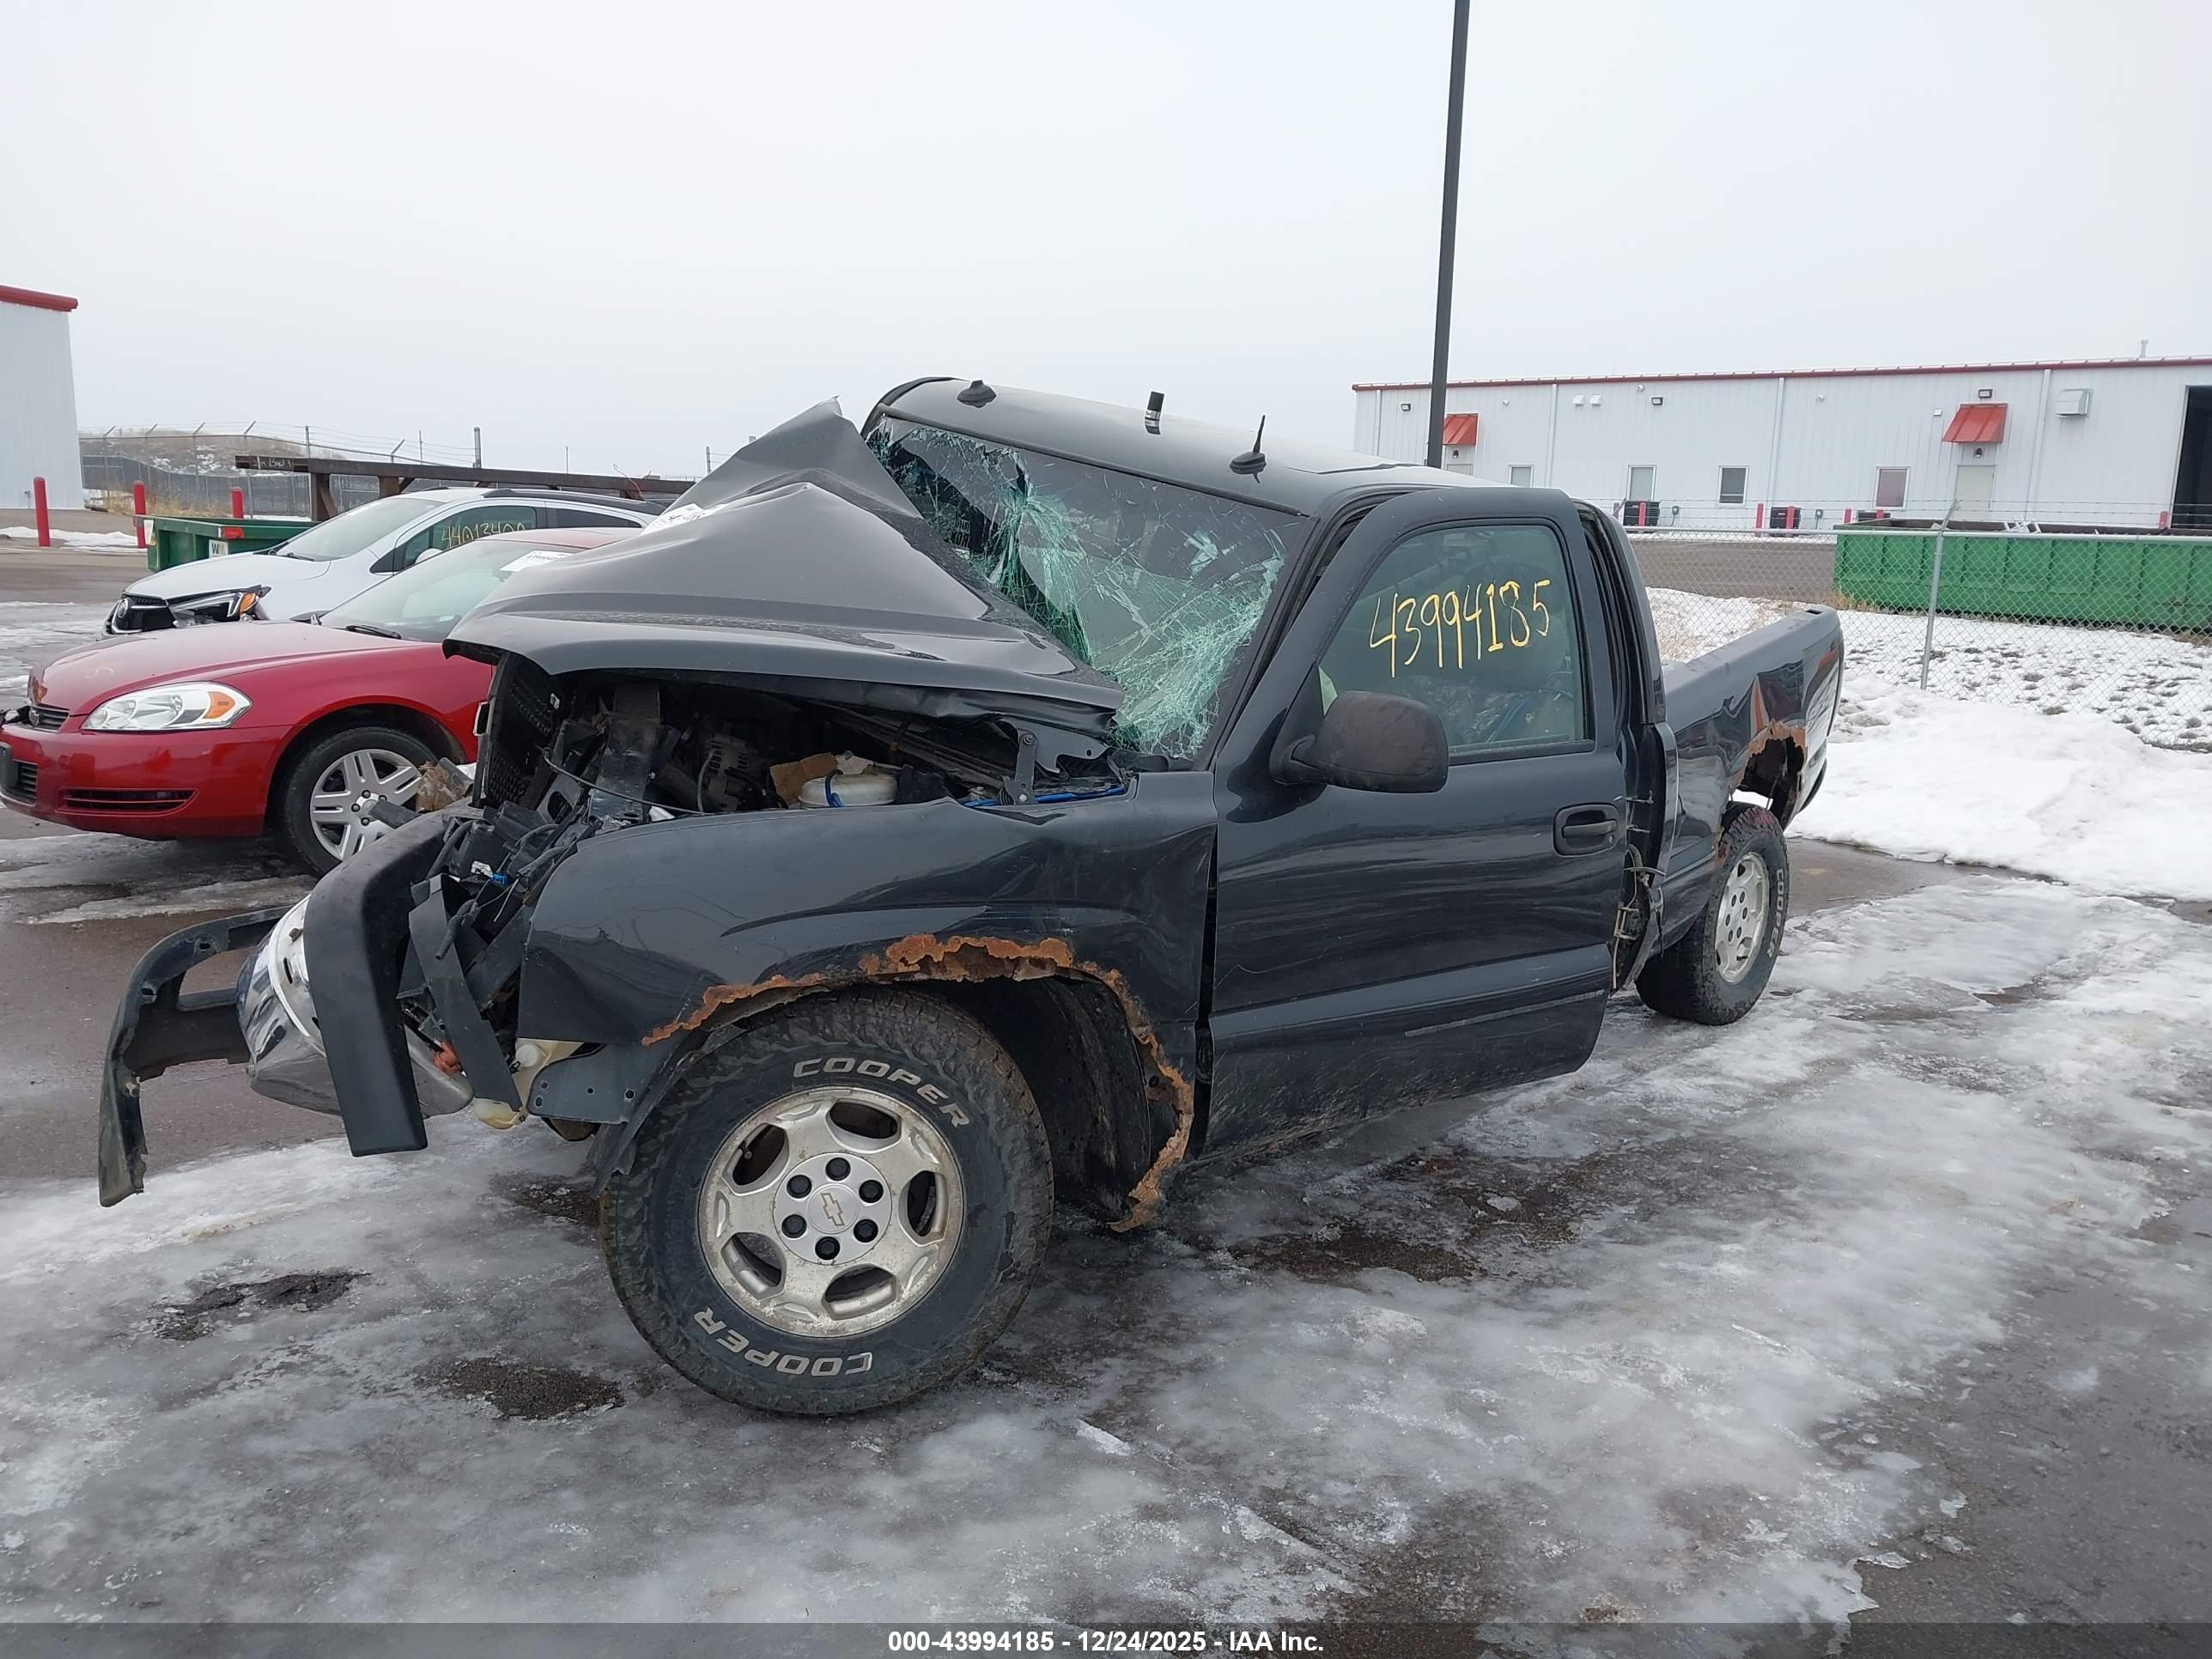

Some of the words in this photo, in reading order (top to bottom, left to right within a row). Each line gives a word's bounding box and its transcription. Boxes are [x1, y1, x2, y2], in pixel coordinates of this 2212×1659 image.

[1370, 580, 1551, 678] 43994185
[1767, 868, 1784, 958] COOPER
[793, 1058, 969, 1127] COOPER
[694, 1307, 872, 1376] COOPER
